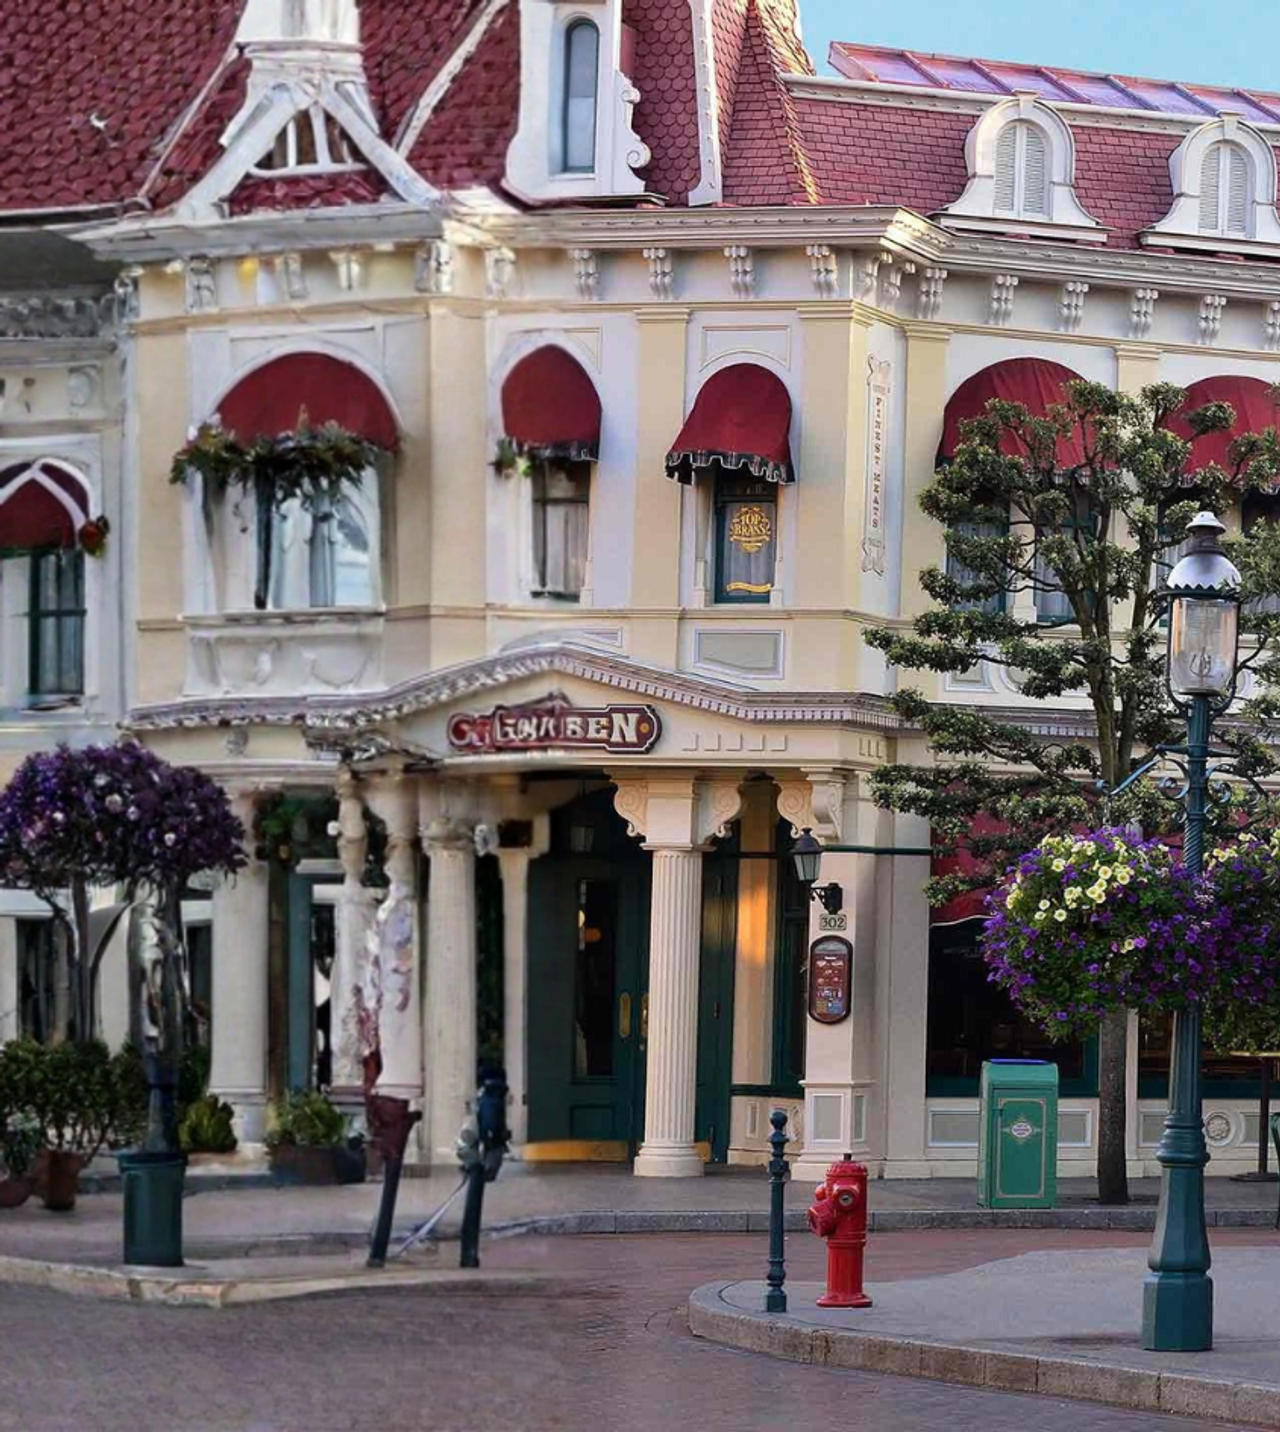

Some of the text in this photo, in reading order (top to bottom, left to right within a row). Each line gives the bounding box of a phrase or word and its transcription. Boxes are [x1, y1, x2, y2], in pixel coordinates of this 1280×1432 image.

[872, 472, 881, 528] MEATS
[741, 513, 761, 525] TOP
[734, 523, 766, 536] BRASS
[821, 916, 845, 928] 302
